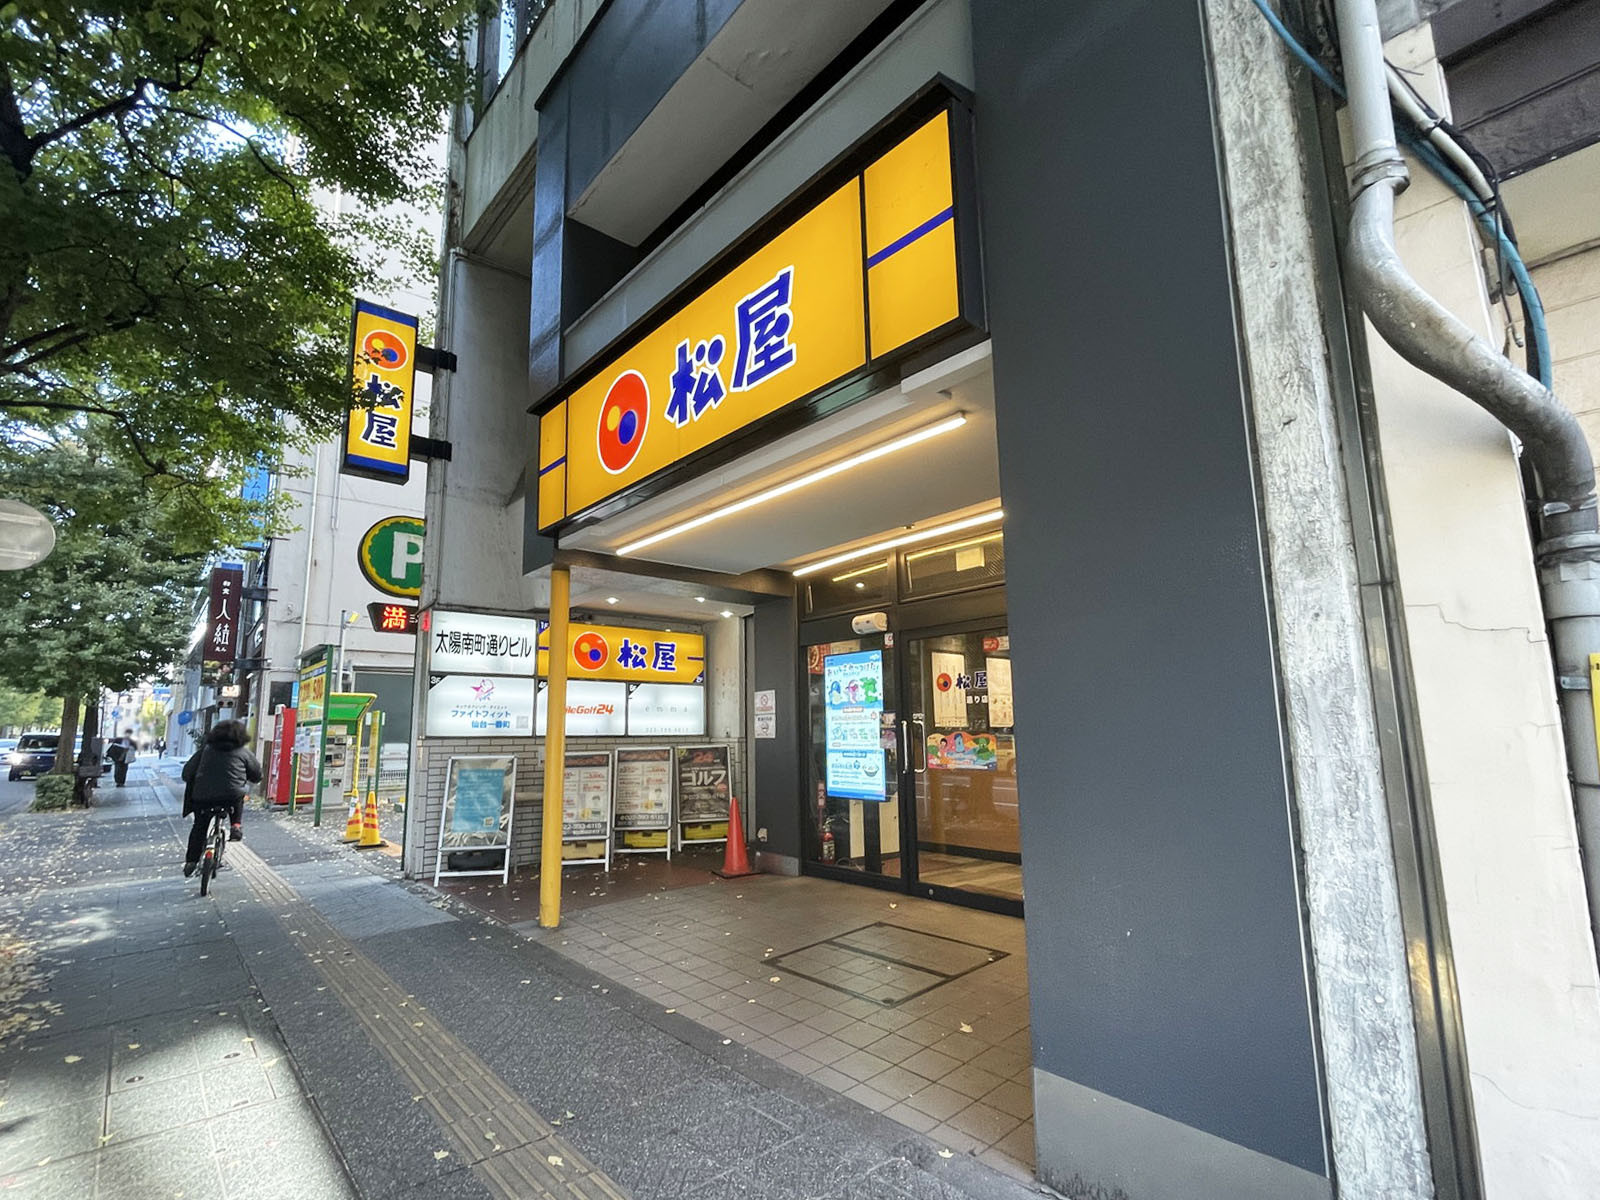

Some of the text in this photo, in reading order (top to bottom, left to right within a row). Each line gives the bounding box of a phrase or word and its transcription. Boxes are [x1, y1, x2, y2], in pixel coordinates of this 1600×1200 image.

[664, 265, 796, 428] 松屋
[361, 373, 401, 449] 松屋
[391, 531, 424, 579] P
[382, 605, 407, 630] 満
[435, 630, 532, 658] 太陽南町通りビル
[617, 638, 677, 672] 松屋
[955, 671, 988, 690] 松屋
[451, 709, 511, 718] ファイトフィット
[471, 720, 511, 728] 仙台一番町
[681, 769, 727, 786] ゴルフ
